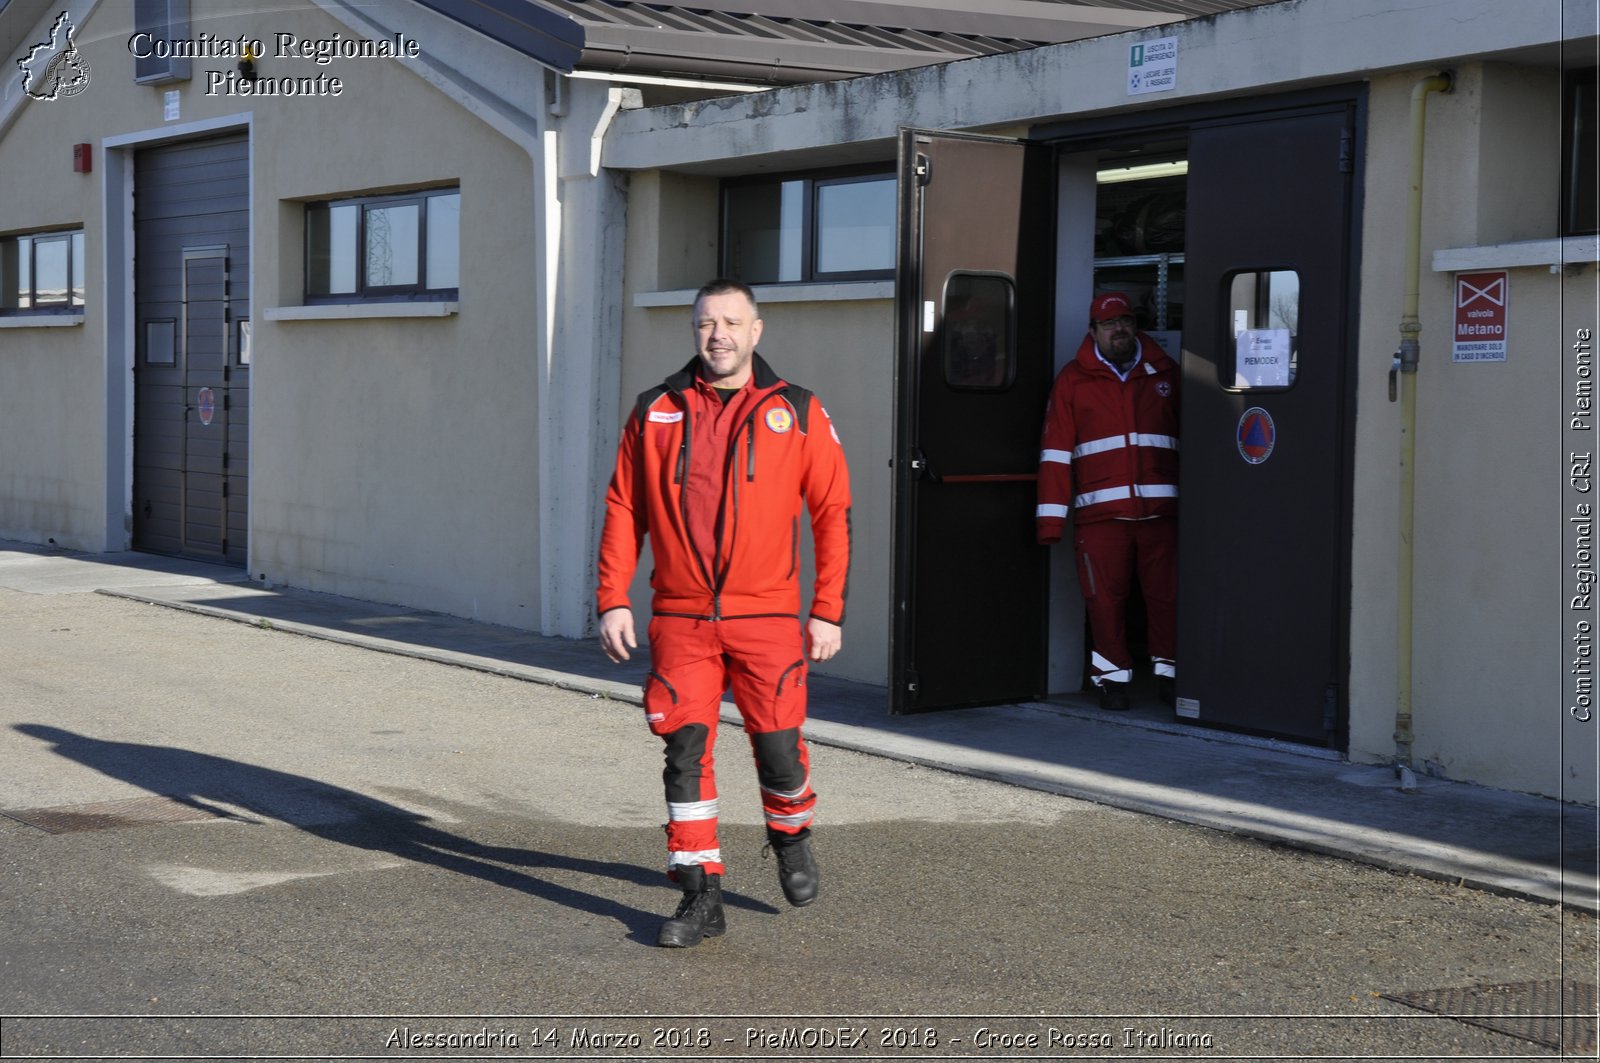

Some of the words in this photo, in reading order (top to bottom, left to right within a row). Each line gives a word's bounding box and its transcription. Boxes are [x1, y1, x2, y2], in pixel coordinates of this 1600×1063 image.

[1147, 44, 1166, 53] USCITA
[1144, 51, 1176, 62] EMERGENZA
[1467, 309, 1494, 318] valvola
[1458, 323, 1502, 335] Metano
[1244, 356, 1279, 366] PIEMODEX
